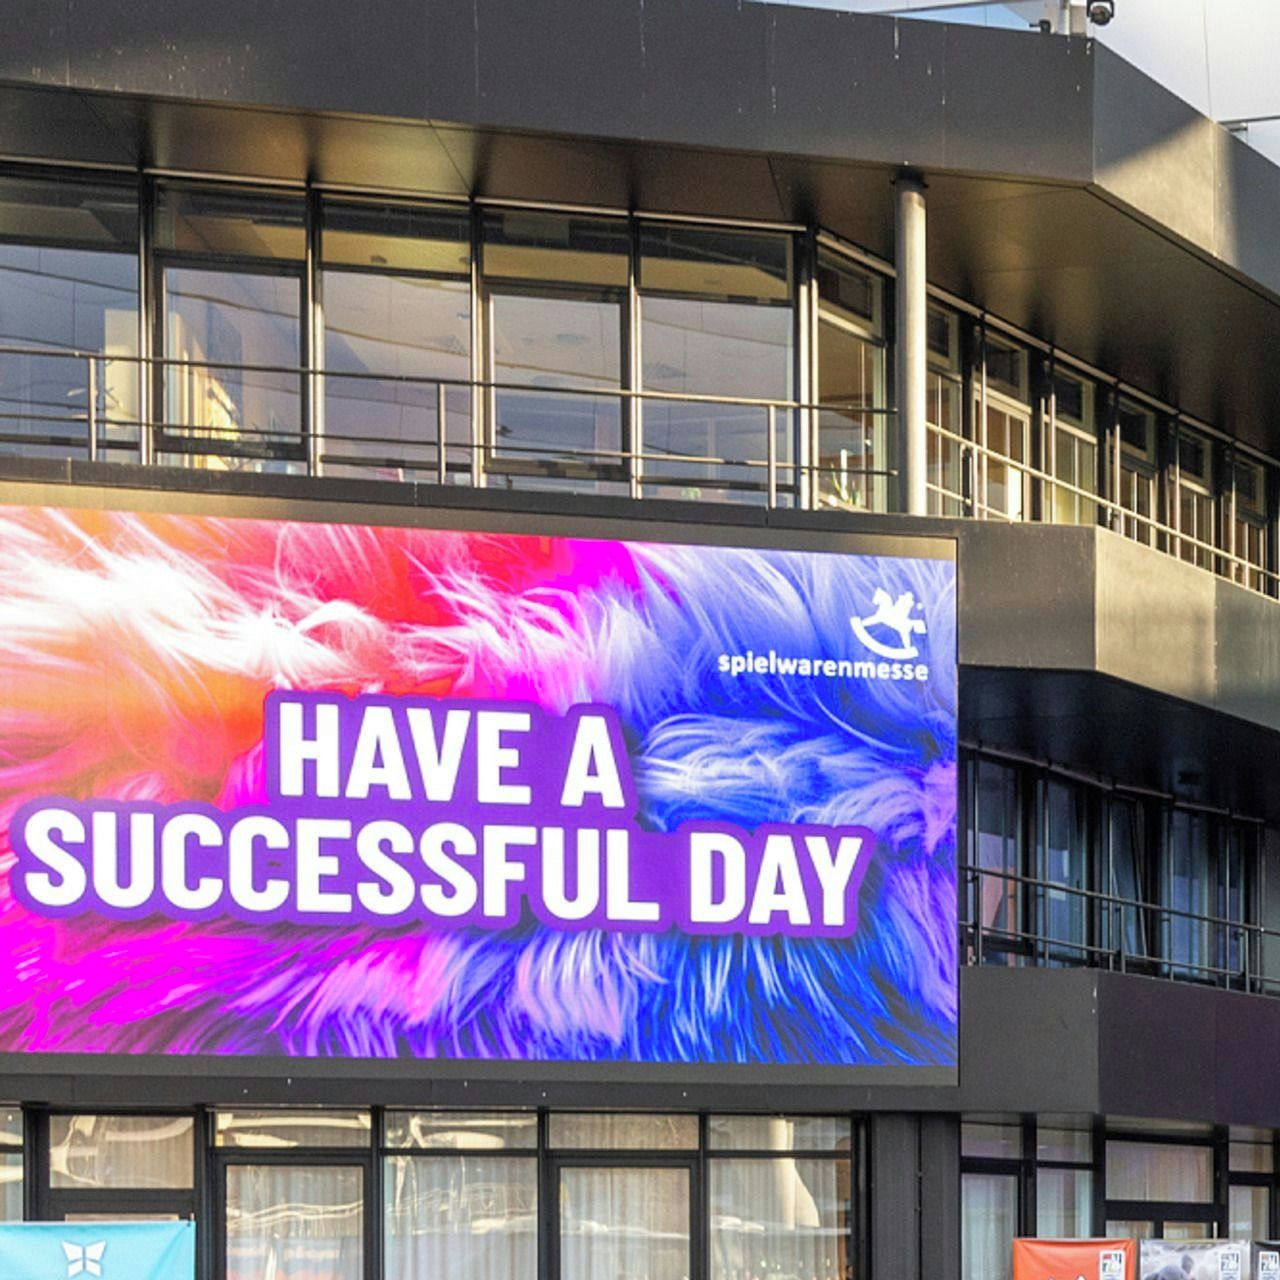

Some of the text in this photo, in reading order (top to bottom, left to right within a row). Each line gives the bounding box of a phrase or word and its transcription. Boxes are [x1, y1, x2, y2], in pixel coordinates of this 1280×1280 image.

[718, 650, 929, 682] spielwarenmesse
[279, 702, 626, 808] HAVE A
[24, 810, 863, 926] SUCCESSFUL DAY
